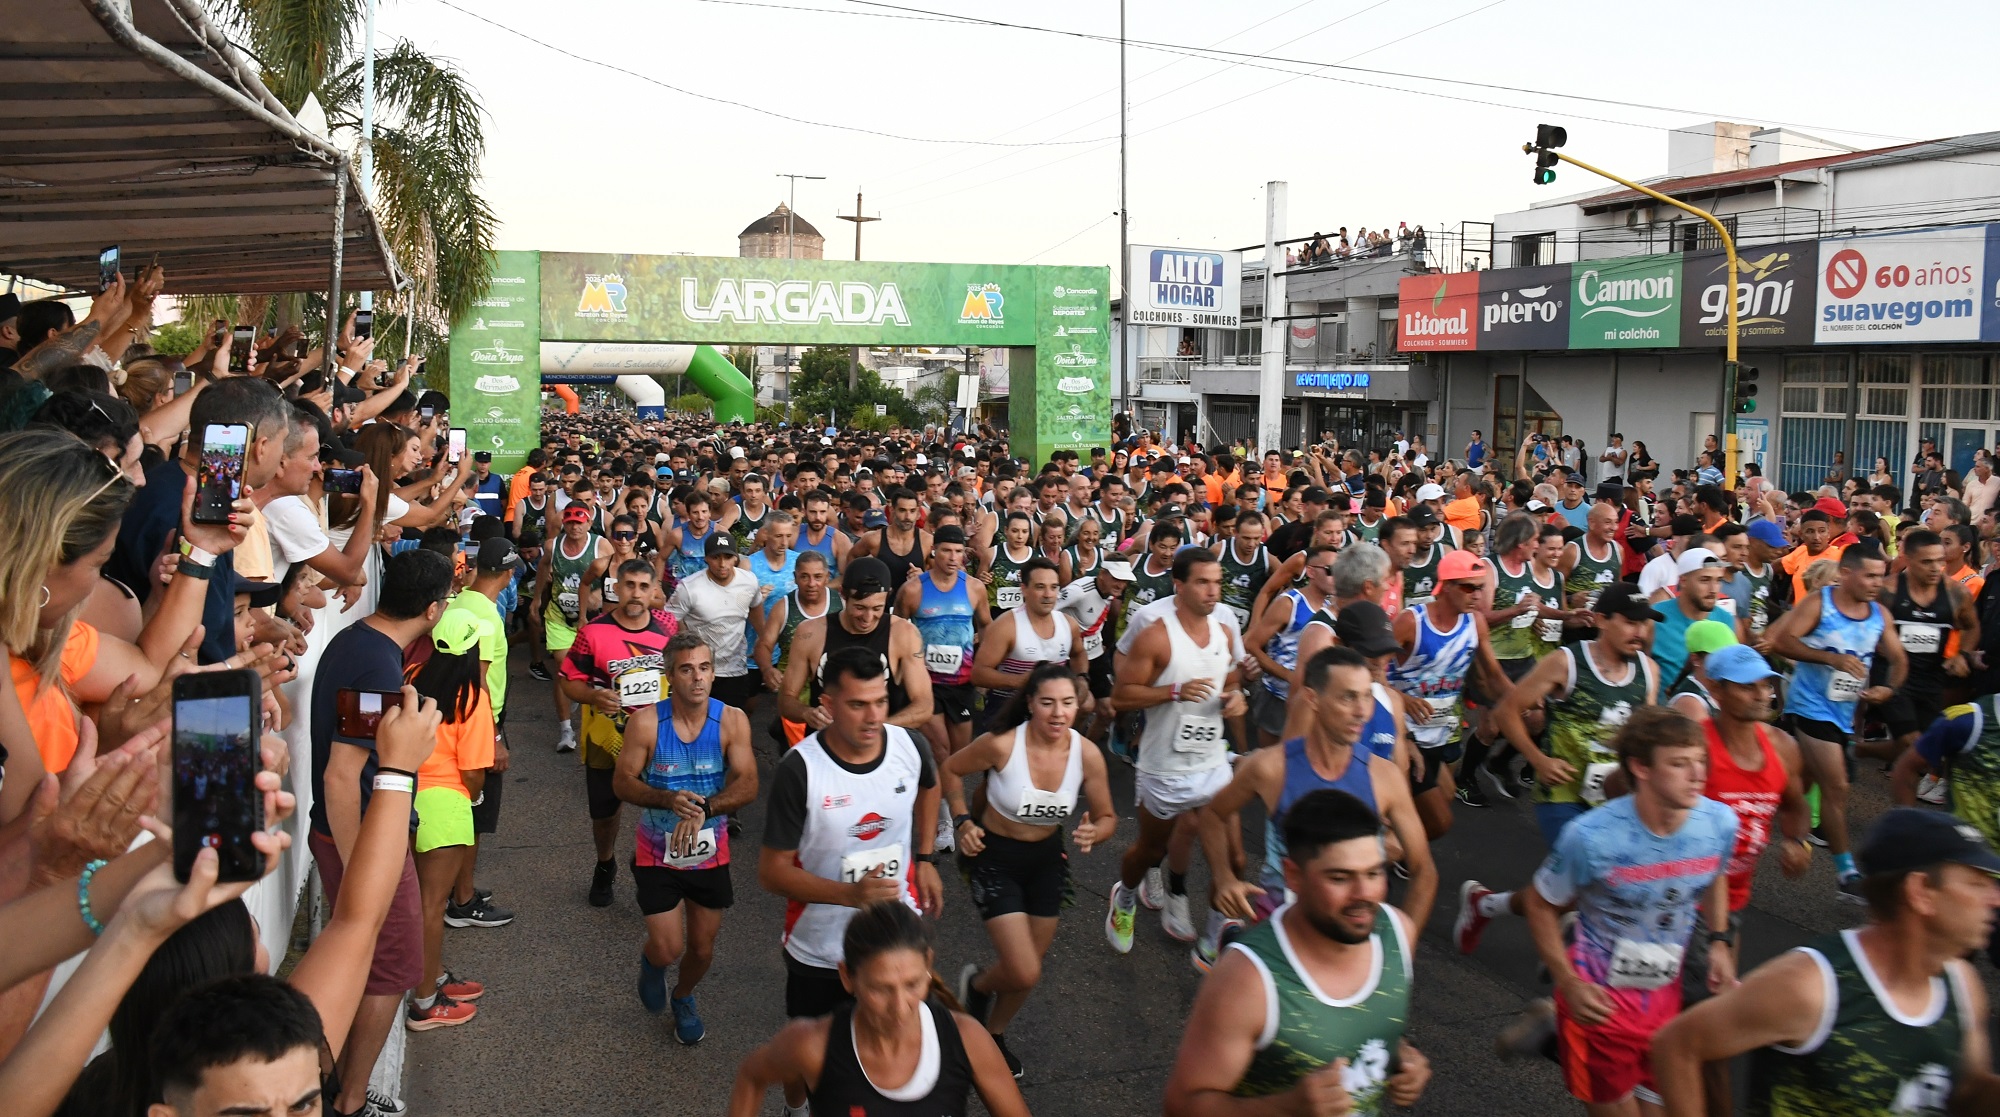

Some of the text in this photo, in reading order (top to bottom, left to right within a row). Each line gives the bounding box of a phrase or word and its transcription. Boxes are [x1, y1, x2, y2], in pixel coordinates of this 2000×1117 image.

[1160, 254, 1214, 284] ALTO
[1874, 262, 1972, 288] 60 años
[1578, 270, 1673, 306] Cannon
[681, 278, 911, 326] LARGADA
[1157, 284, 1215, 308] HOGAR
[1133, 310, 1182, 324] COLCHONES
[1192, 312, 1238, 327] SOMMIERS
[1484, 292, 1556, 332] piero
[1823, 298, 1973, 326] suavegom
[1405, 308, 1468, 336] Litoral
[1822, 324, 1829, 332] EL
[1830, 324, 1854, 332] NOMBRE
[1867, 322, 1902, 330] COLCHÓN
[1604, 326, 1660, 340] mi colchón
[1704, 326, 1785, 338] colchos y sommiers
[470, 350, 524, 364] Doña Pupa
[592, 360, 620, 368] ciudad
[1054, 354, 1097, 366] Doña Pupa
[480, 382, 516, 391] Hermanos
[1061, 383, 1090, 391] Hermanos
[1353, 373, 1370, 387] SUR
[1000, 592, 1021, 602] 376
[928, 652, 959, 664] 1037
[624, 680, 658, 696] 1229
[1182, 724, 1216, 742] 565
[1020, 803, 1068, 818] 1585
